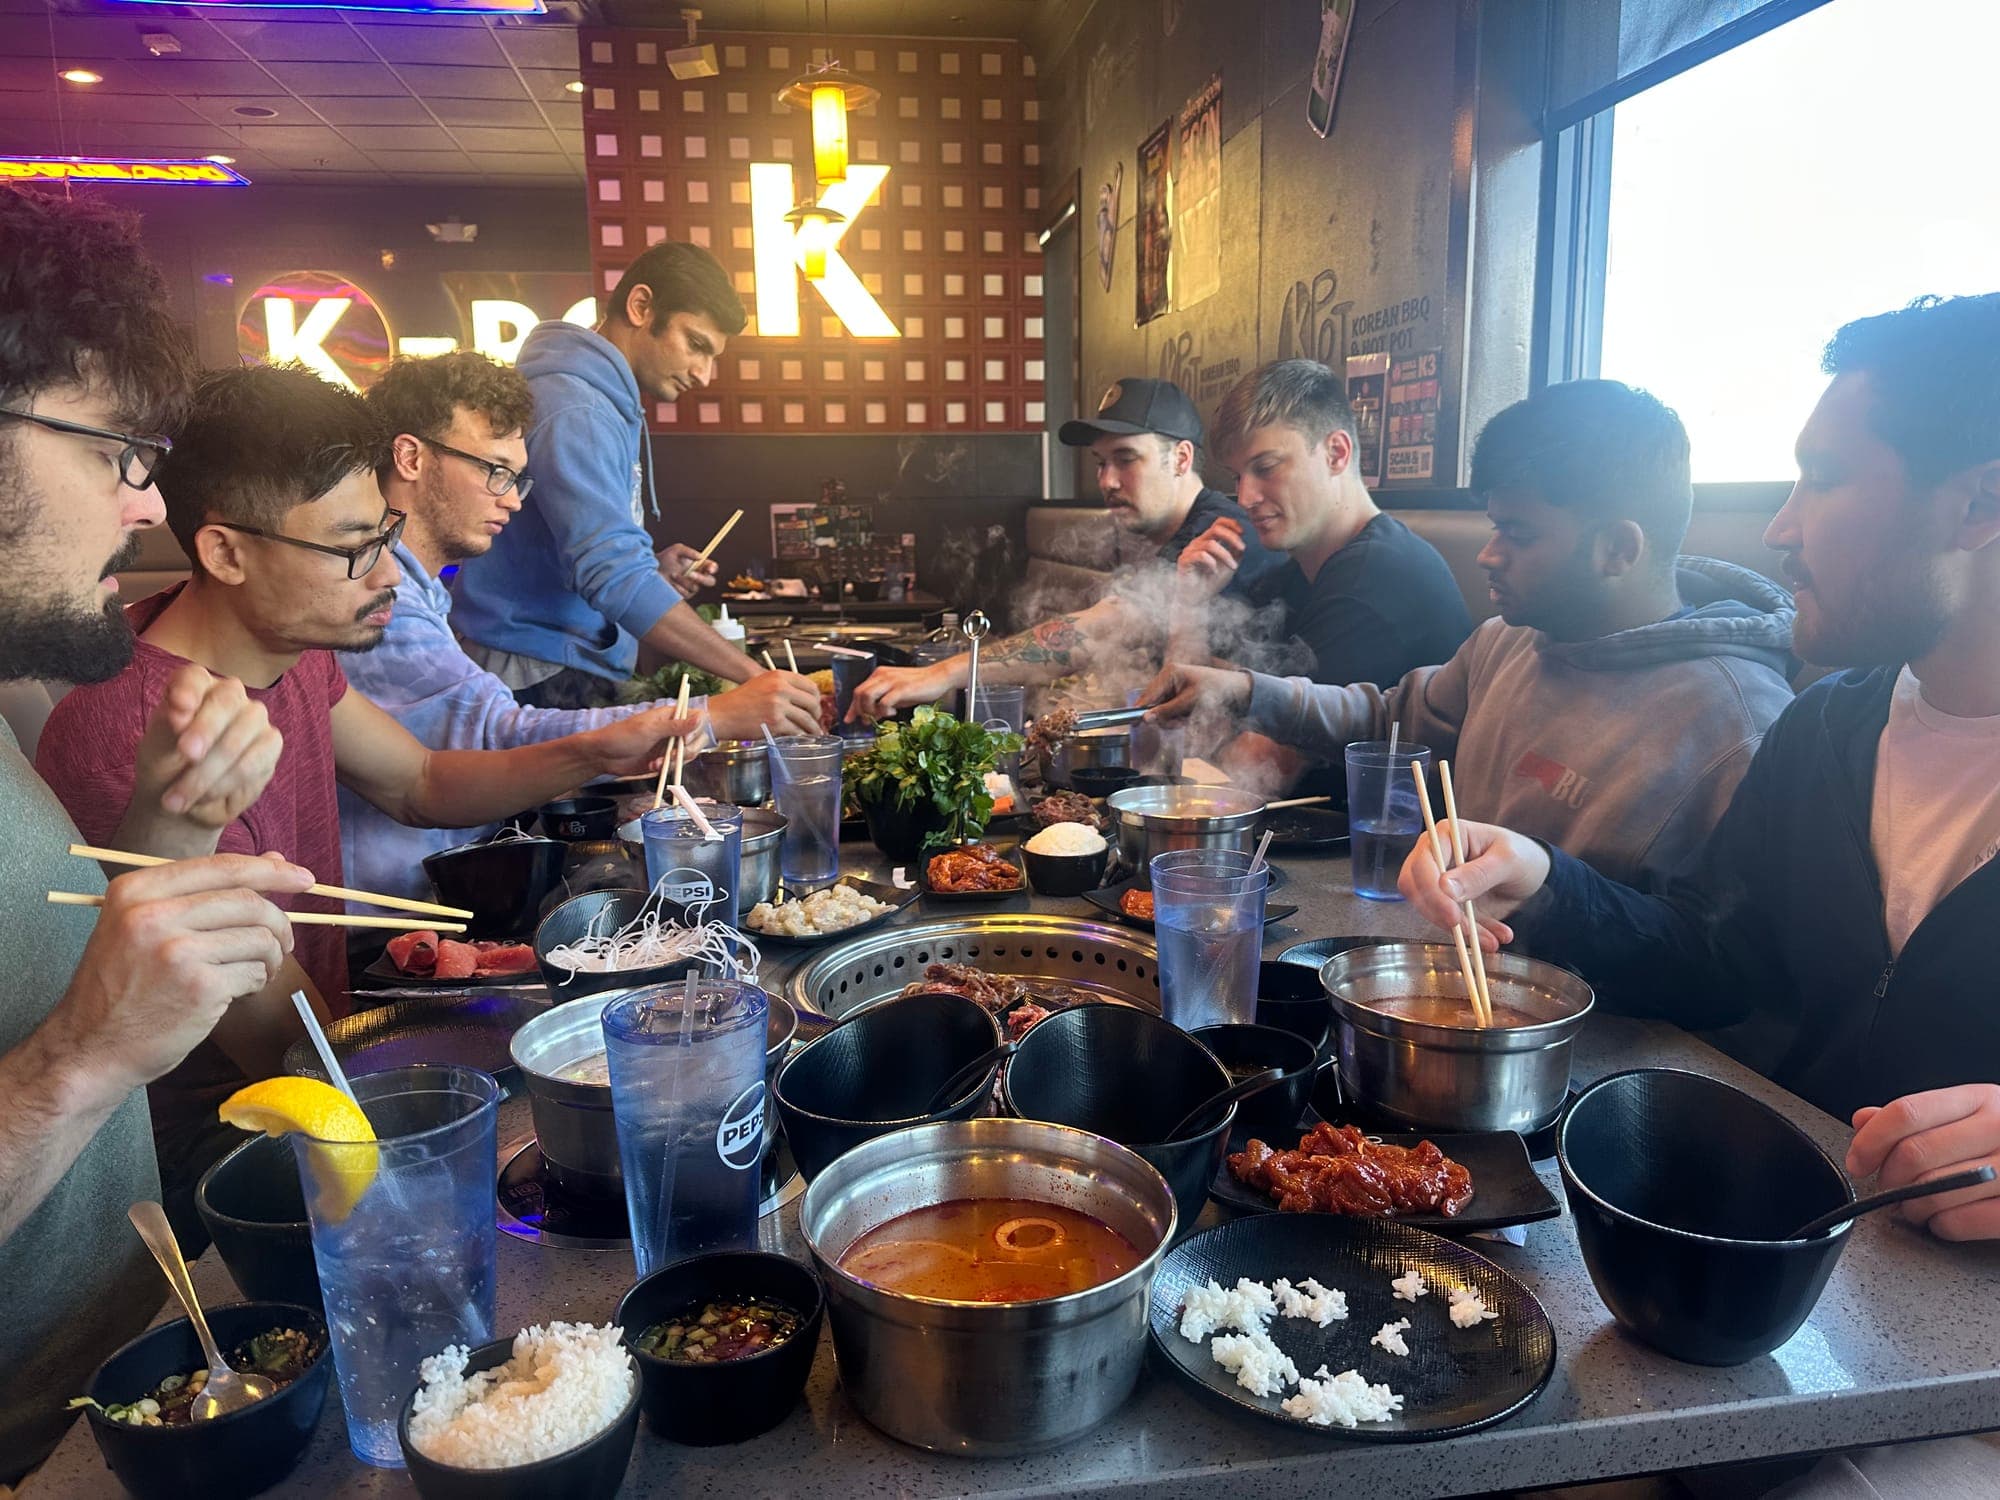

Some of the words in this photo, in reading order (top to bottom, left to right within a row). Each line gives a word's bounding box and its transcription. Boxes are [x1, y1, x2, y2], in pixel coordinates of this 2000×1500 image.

[749, 163, 902, 338] K
[1351, 305, 1399, 338] KOREAN
[1401, 296, 1430, 323] BBQ
[263, 297, 596, 395] K-P
[1362, 335, 1387, 354] HOT
[1390, 327, 1417, 352] POT
[664, 886, 710, 898] PEPSI
